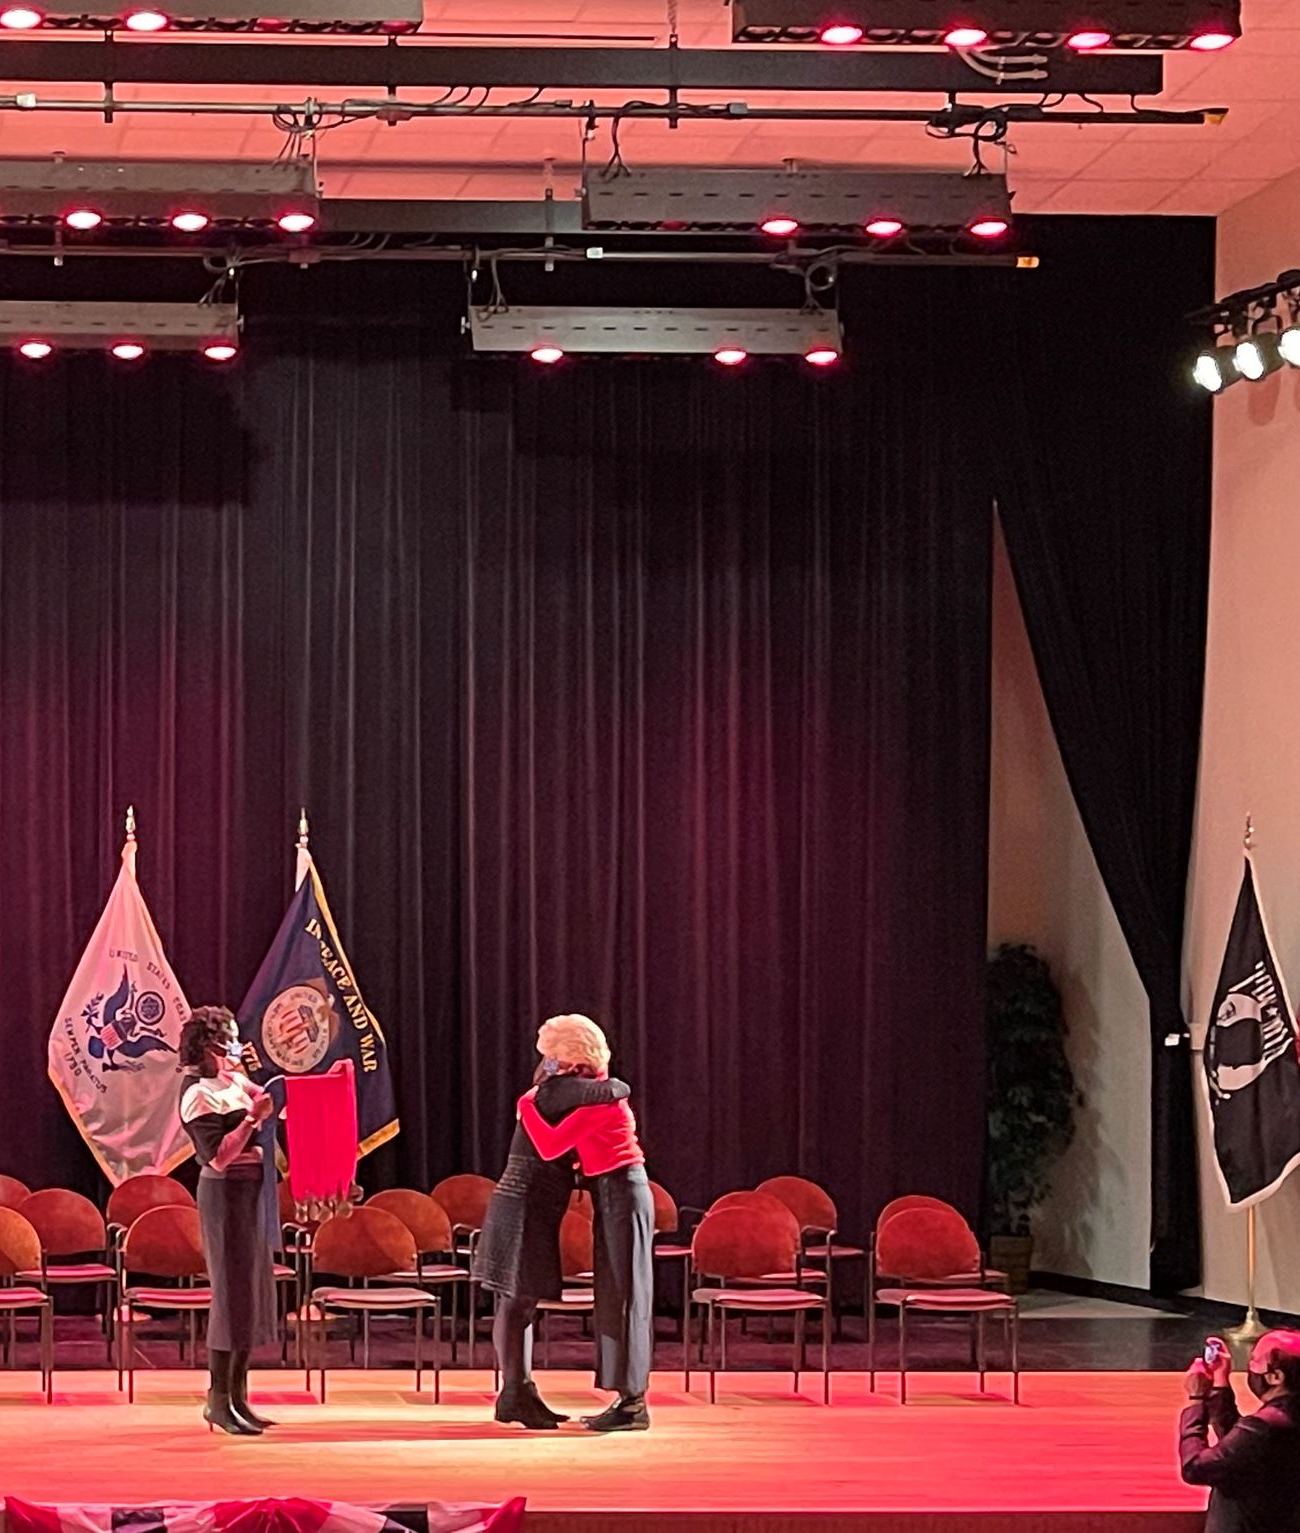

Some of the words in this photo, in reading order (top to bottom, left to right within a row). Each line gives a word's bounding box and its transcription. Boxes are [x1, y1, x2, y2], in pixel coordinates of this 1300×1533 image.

[304, 918, 321, 940] IN
[343, 994, 368, 1030] AND
[359, 1033, 378, 1073] WAR
